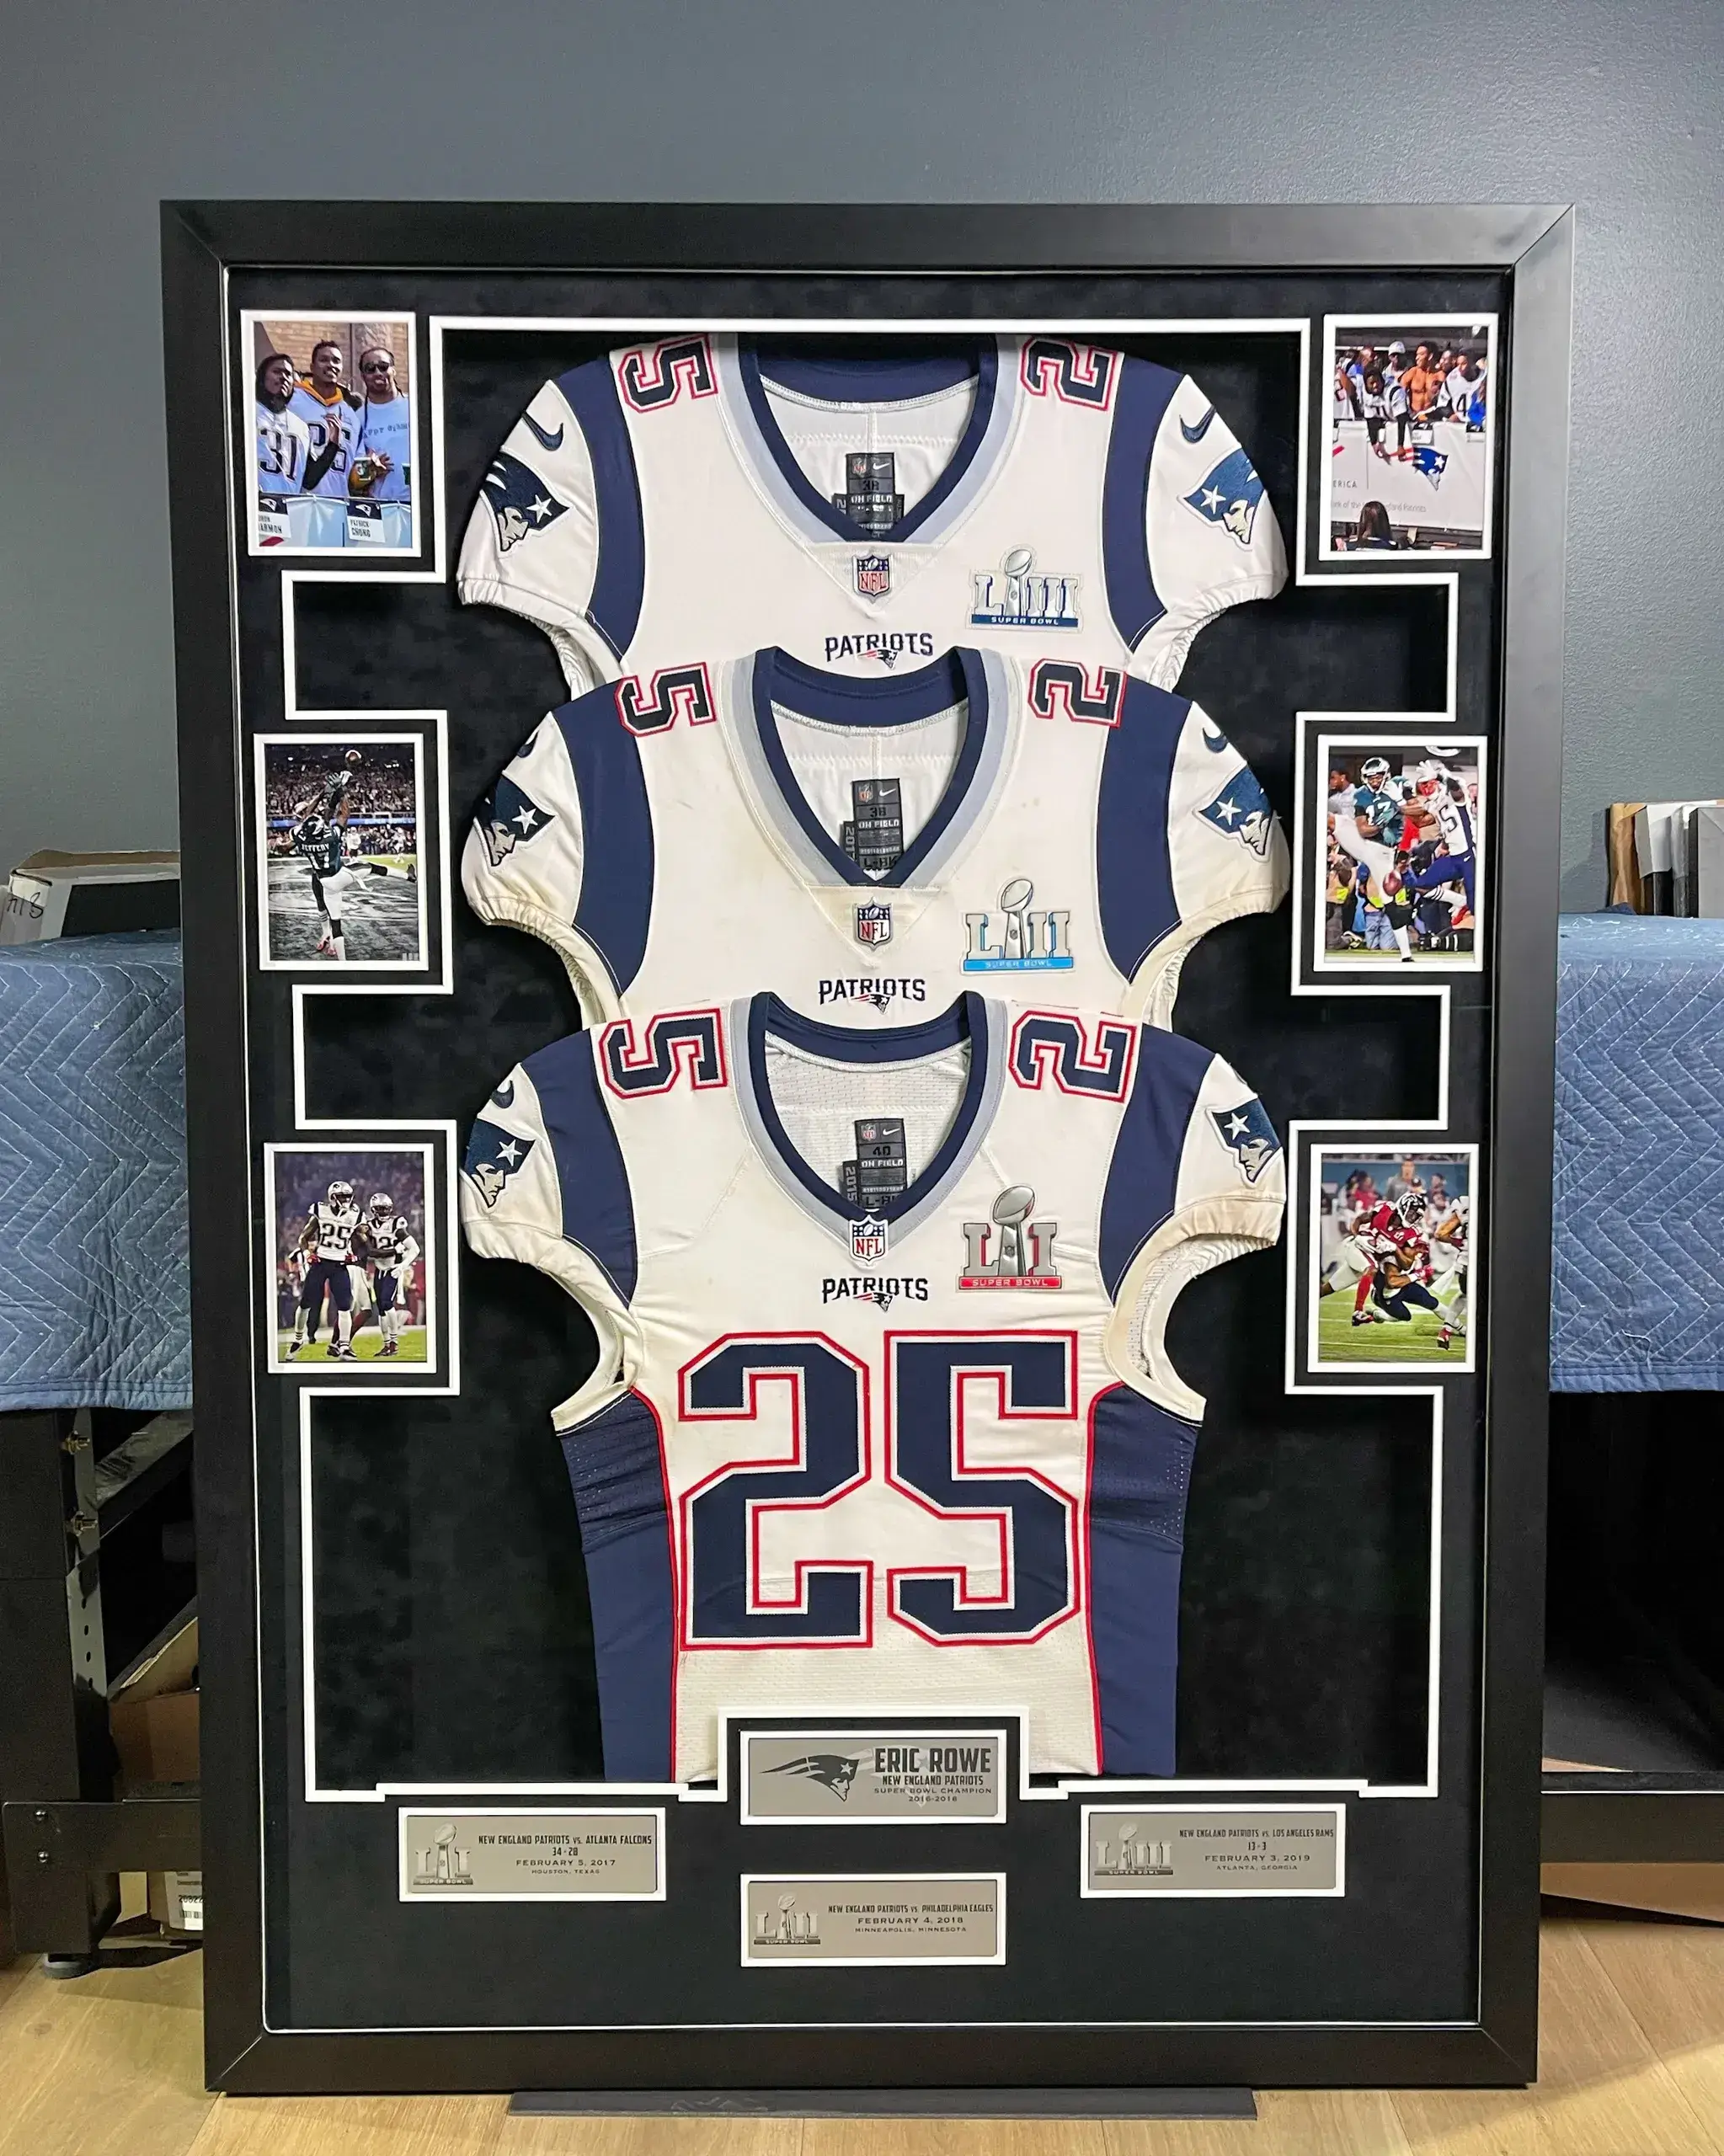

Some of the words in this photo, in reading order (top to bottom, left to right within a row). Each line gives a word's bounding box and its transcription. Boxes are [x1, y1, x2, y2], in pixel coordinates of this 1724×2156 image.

[259, 428, 297, 481] 31
[867, 494, 893, 503] FIELD
[859, 574, 889, 590] NFL
[990, 616, 1027, 624] SUPER
[825, 632, 933, 662] PATRIOTS
[874, 819, 899, 828] FIELD
[860, 921, 888, 938] NFL
[818, 978, 926, 1006] PATRIOTS
[861, 1160, 875, 1168] ON
[878, 1158, 904, 1167] FIELD
[846, 1166, 857, 1202] 2015
[320, 1224, 350, 1250] 25
[855, 1238, 883, 1256] NFL
[822, 1278, 928, 1304] PATRIOTS
[678, 1330, 1081, 1652] 25
[874, 1748, 920, 1773] ERIC
[926, 1748, 991, 1773] ROWE
[882, 1775, 900, 1785] NEW
[905, 1775, 942, 1785] ENGLAND
[944, 1774, 984, 1785] PATRIOTS
[478, 1835, 495, 1844] NEW
[498, 1835, 532, 1844] ENGLAND
[534, 1835, 570, 1844] PATRIOTS
[585, 1835, 617, 1844] ATLANTA
[620, 1835, 652, 1844] FALCONS
[1179, 1829, 1194, 1838] NEW
[1196, 1829, 1226, 1838] ENGLAND
[1228, 1829, 1259, 1838] PATRIOTS
[1273, 1829, 1284, 1838] LOS
[1285, 1829, 1314, 1838] ANGELES
[1316, 1829, 1334, 1838] RAMS
[828, 1905, 843, 1913] NEW
[845, 1905, 875, 1913] ENGLAND
[877, 1905, 909, 1913] PATRIOTS
[921, 1904, 969, 1913] PHILADELPHIA
[969, 1904, 993, 1913] EAGLES
